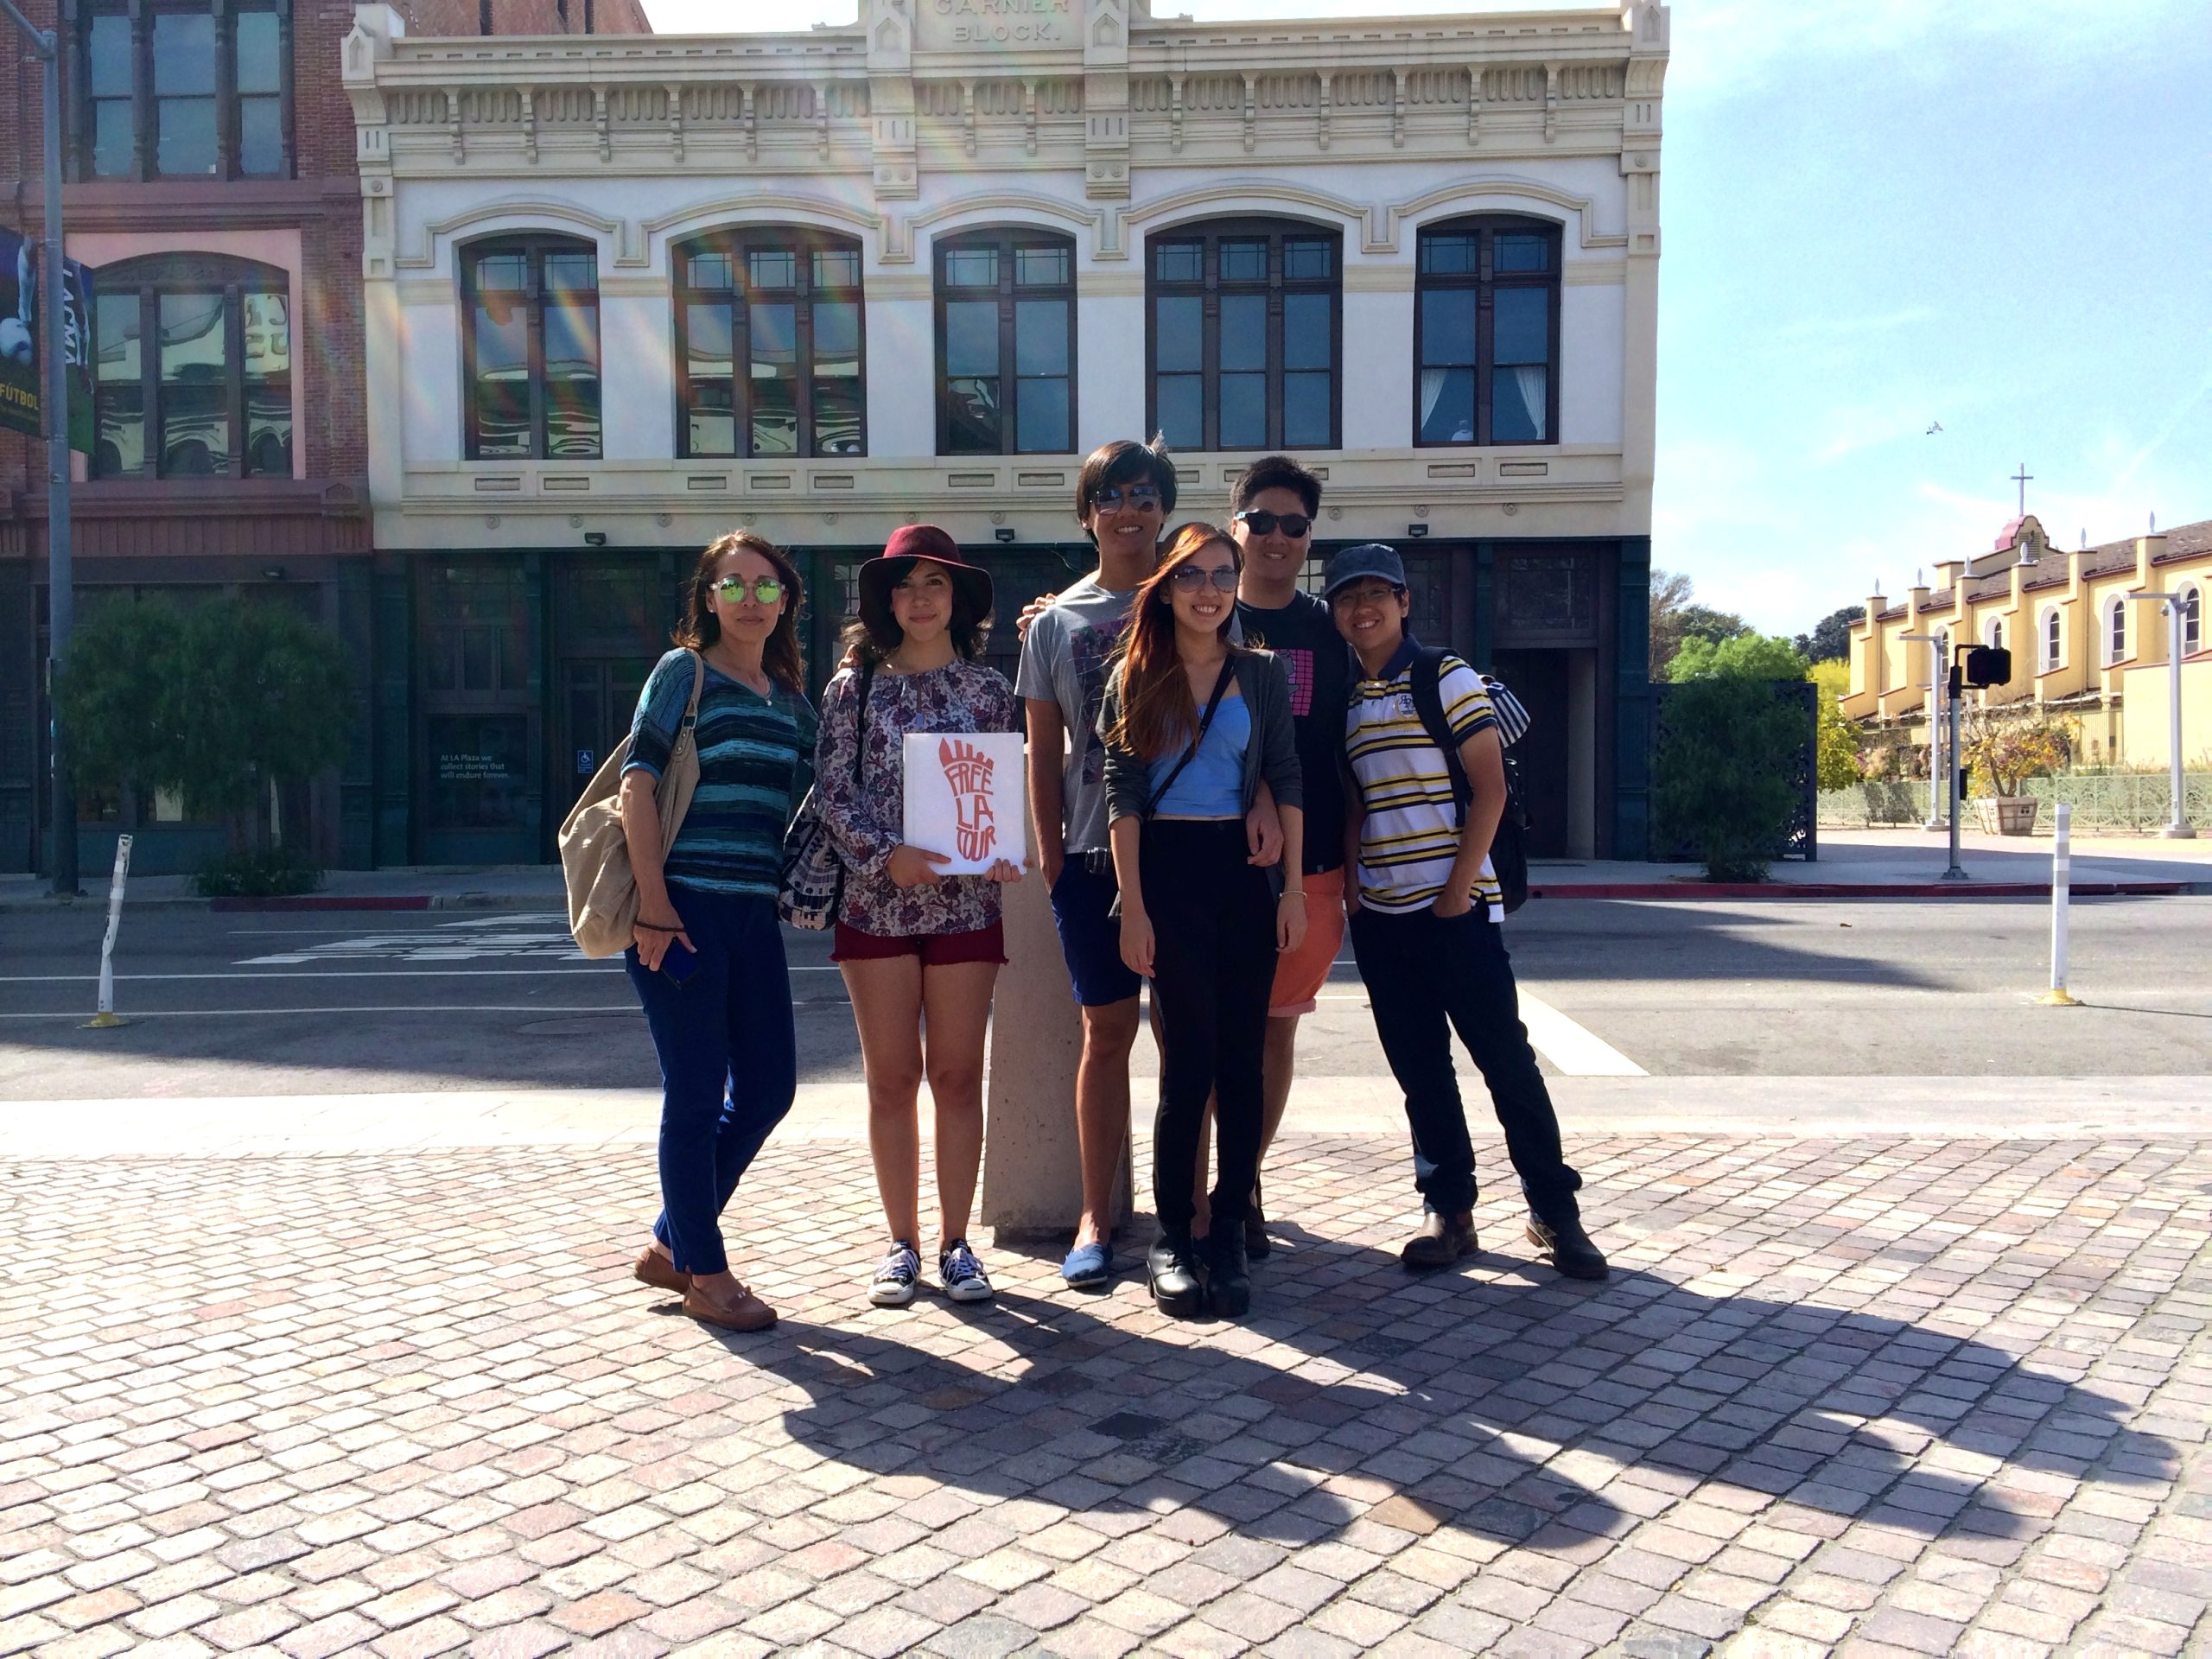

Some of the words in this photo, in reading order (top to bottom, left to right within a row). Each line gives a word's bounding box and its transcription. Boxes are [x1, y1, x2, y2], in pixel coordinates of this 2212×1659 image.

[0, 382, 40, 410] FÚTBOL
[944, 762, 994, 797] FREE
[956, 794, 995, 830] LA
[956, 824, 996, 862] TOUR
